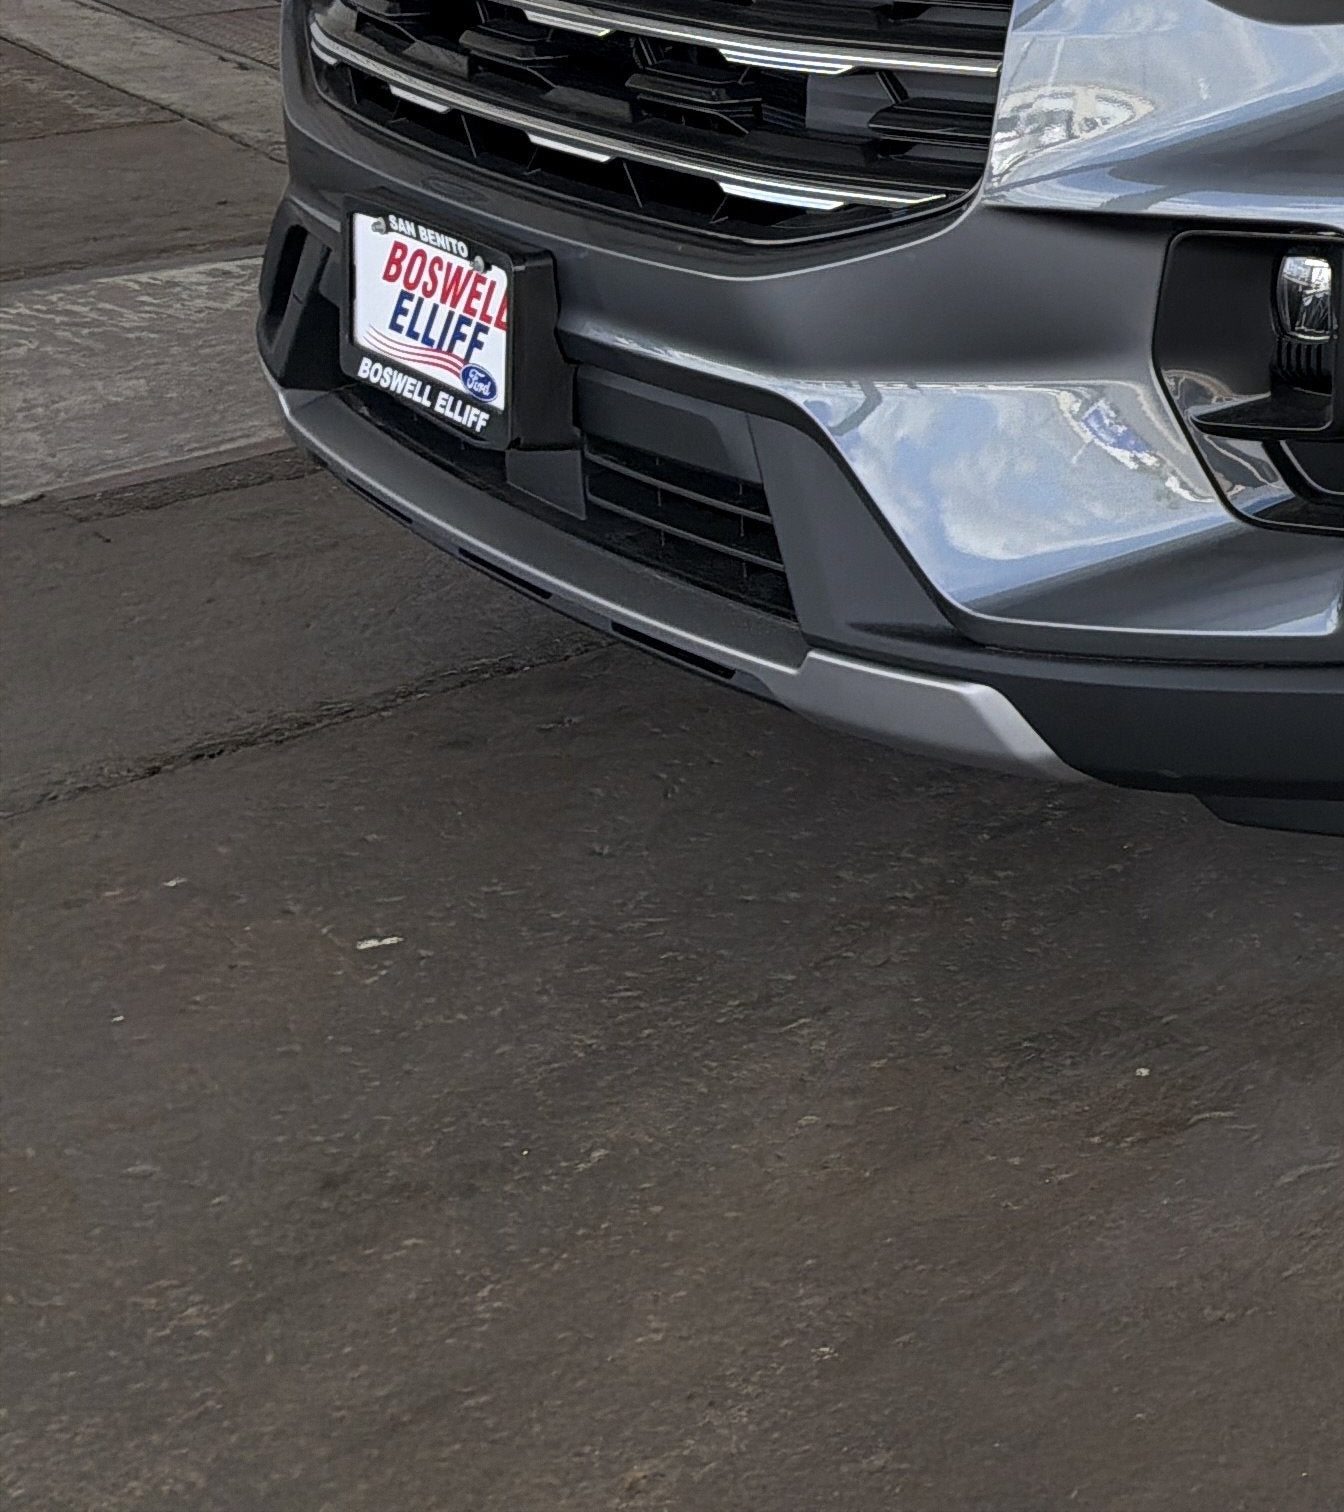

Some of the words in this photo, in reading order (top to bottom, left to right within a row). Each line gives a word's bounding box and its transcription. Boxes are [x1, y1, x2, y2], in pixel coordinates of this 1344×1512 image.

[388, 214, 417, 238] SAN
[419, 225, 469, 258] BENITO
[382, 240, 508, 331] BOSWELL
[387, 289, 491, 364] ELLIFF
[357, 357, 432, 408] BOSWELL
[434, 394, 491, 433] ELLIFF
[466, 370, 491, 397] Ford
